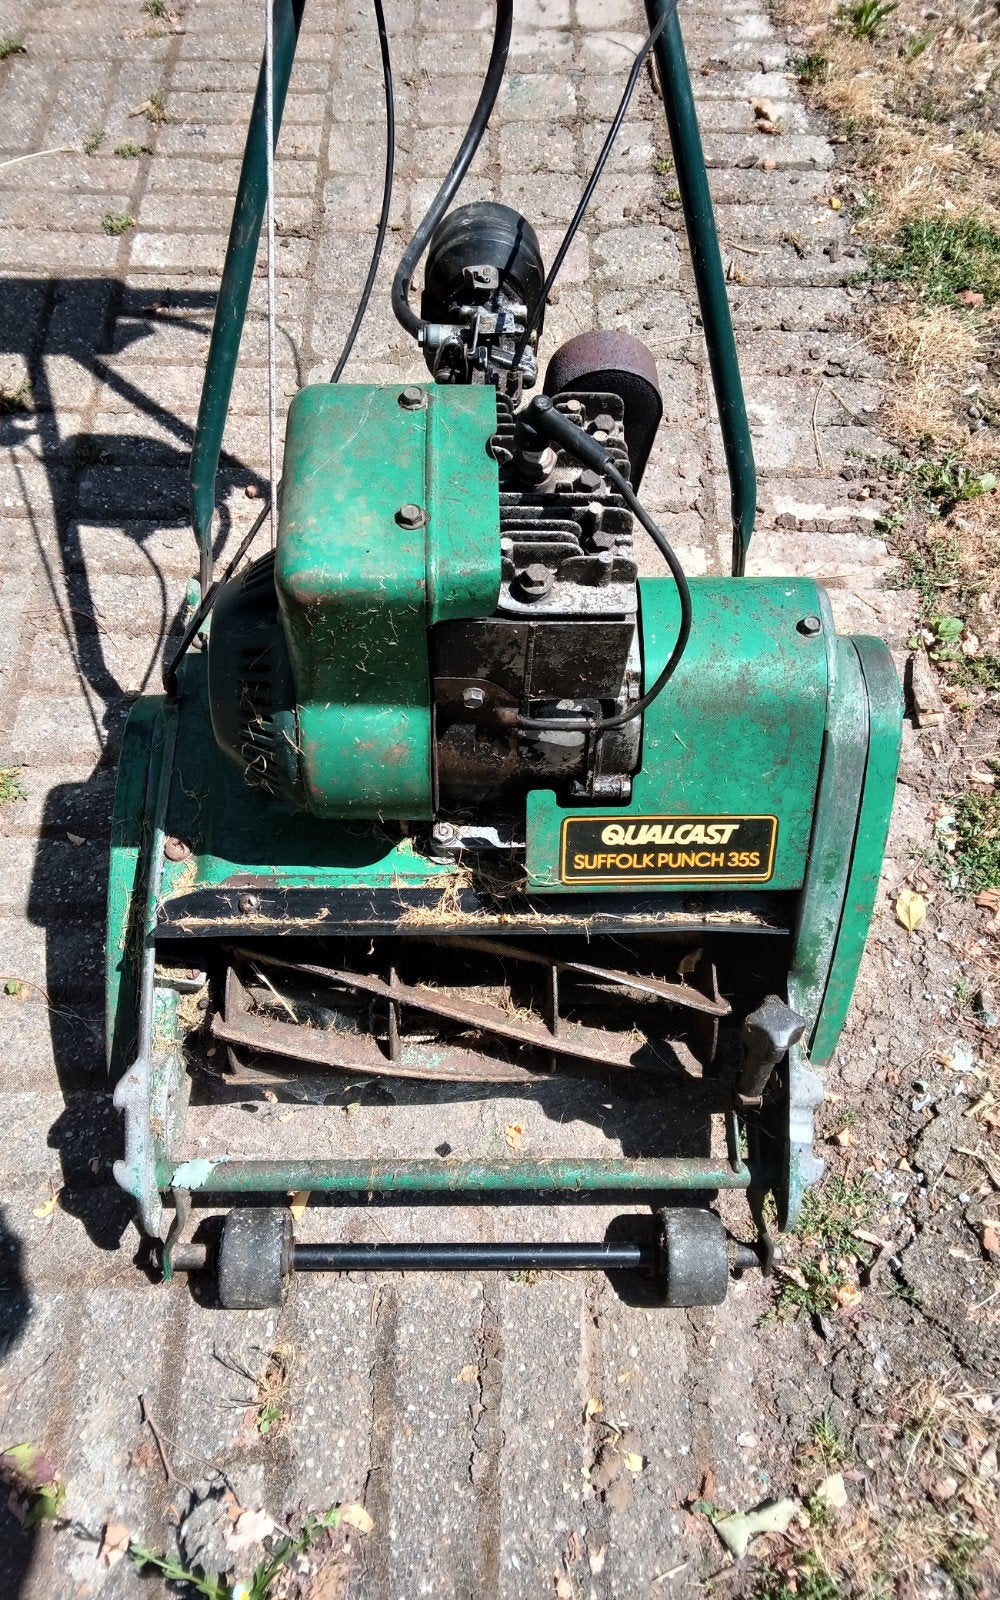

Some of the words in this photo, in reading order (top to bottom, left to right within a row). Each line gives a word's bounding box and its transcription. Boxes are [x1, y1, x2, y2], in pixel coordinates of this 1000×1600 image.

[601, 824, 739, 846] QUALCAST
[573, 853, 655, 869] SUFFOLK
[658, 852, 724, 867] PUNCH
[727, 851, 760, 867] 35S
